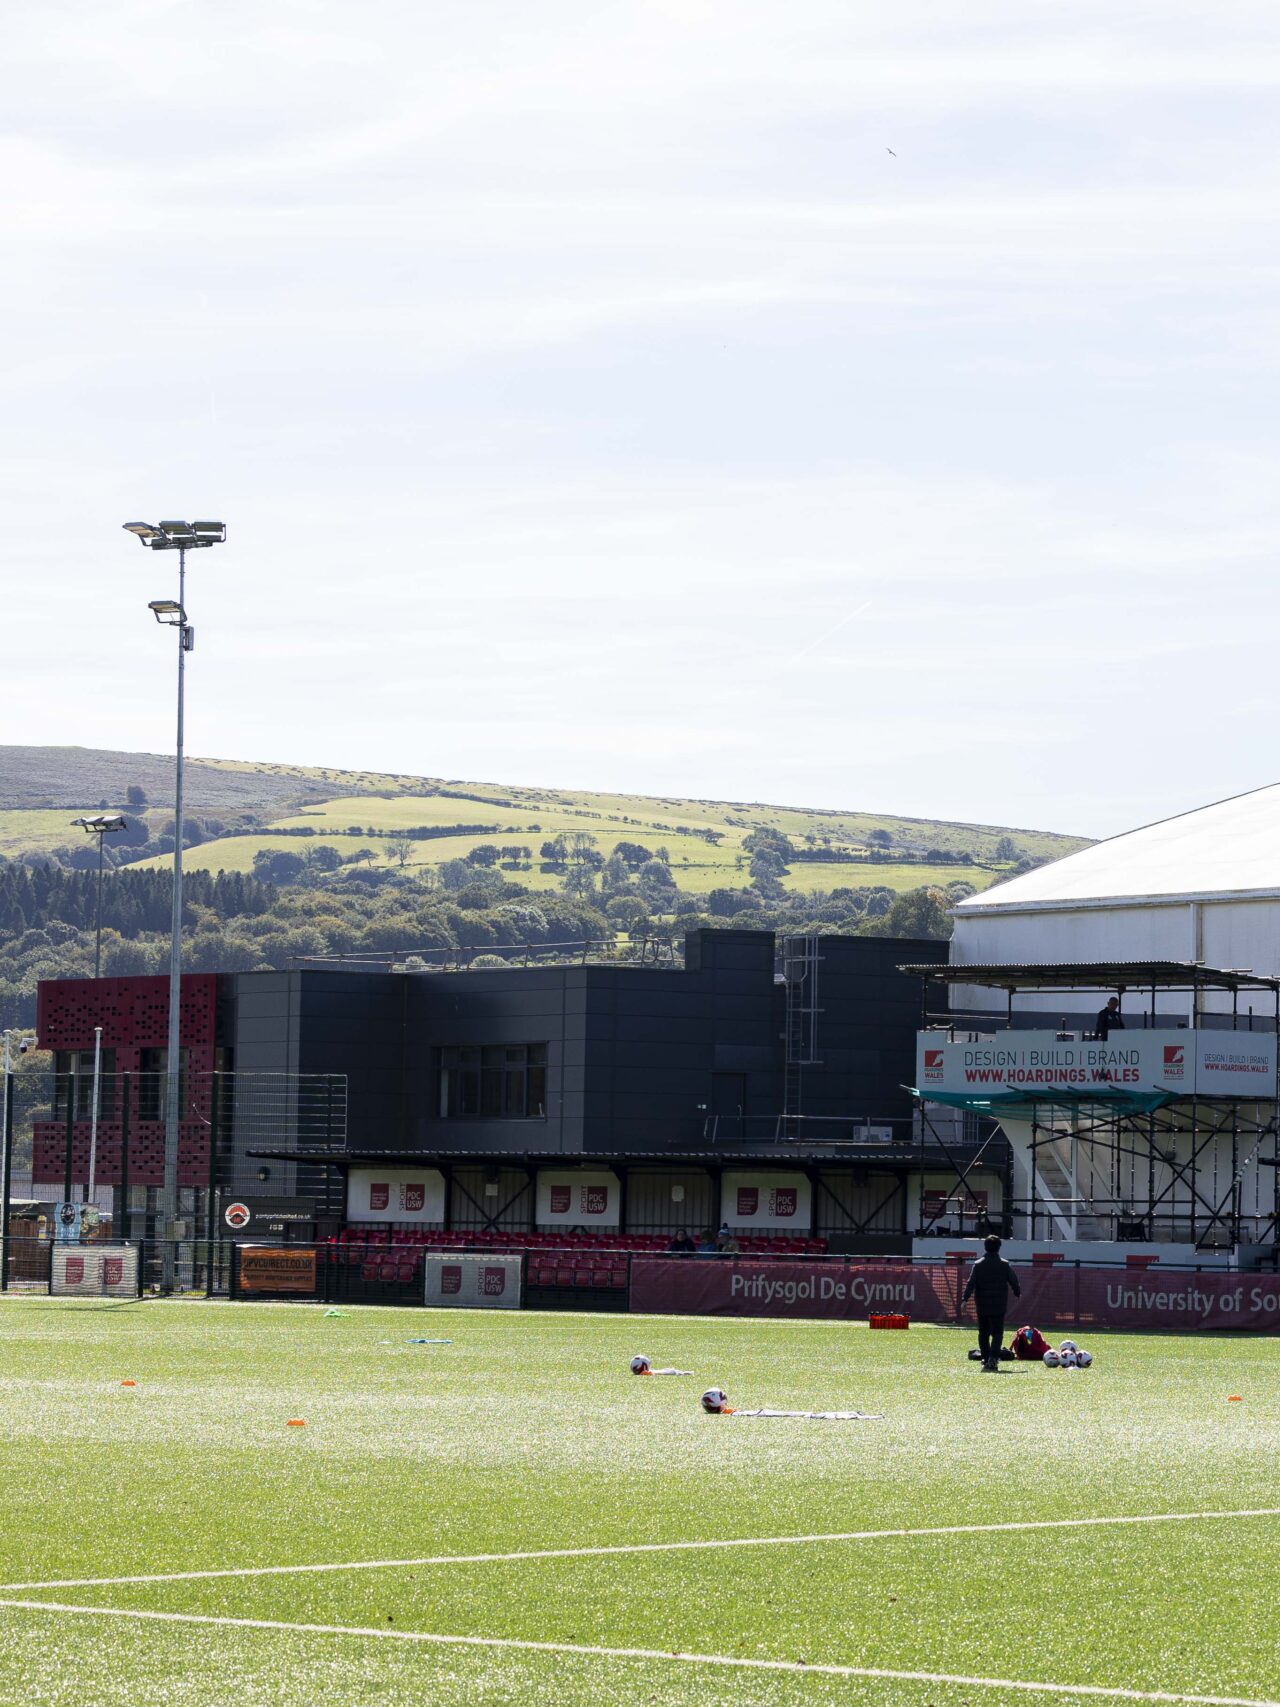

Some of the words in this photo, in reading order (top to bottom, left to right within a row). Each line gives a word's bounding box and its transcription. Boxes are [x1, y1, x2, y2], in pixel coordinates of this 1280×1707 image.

[965, 1051, 1017, 1066] DESIGN
[1030, 1050, 1074, 1066] BUILD
[1088, 1050, 1140, 1066] BRAND
[1204, 1053, 1225, 1062] DESIGN
[1229, 1054, 1246, 1063] BUILD
[1249, 1055, 1268, 1065] BRAND
[1204, 1062, 1269, 1073] WWW.HOARDINGS.WALES
[965, 1068, 1140, 1083] WWW.HOARDINGS.WALES
[407, 1192, 420, 1200] PDC
[588, 1194, 604, 1202] PDC
[777, 1196, 792, 1204] PDC
[406, 1200, 422, 1208] USW
[588, 1202, 605, 1211] USW
[777, 1205, 794, 1214] USW
[486, 1275, 500, 1284] PDC
[486, 1284, 502, 1292] USW
[731, 1274, 815, 1304] Prifysgol
[820, 1277, 846, 1300] De
[851, 1277, 915, 1306] Cymru
[1107, 1285, 1215, 1317] University
[1219, 1287, 1243, 1312] of
